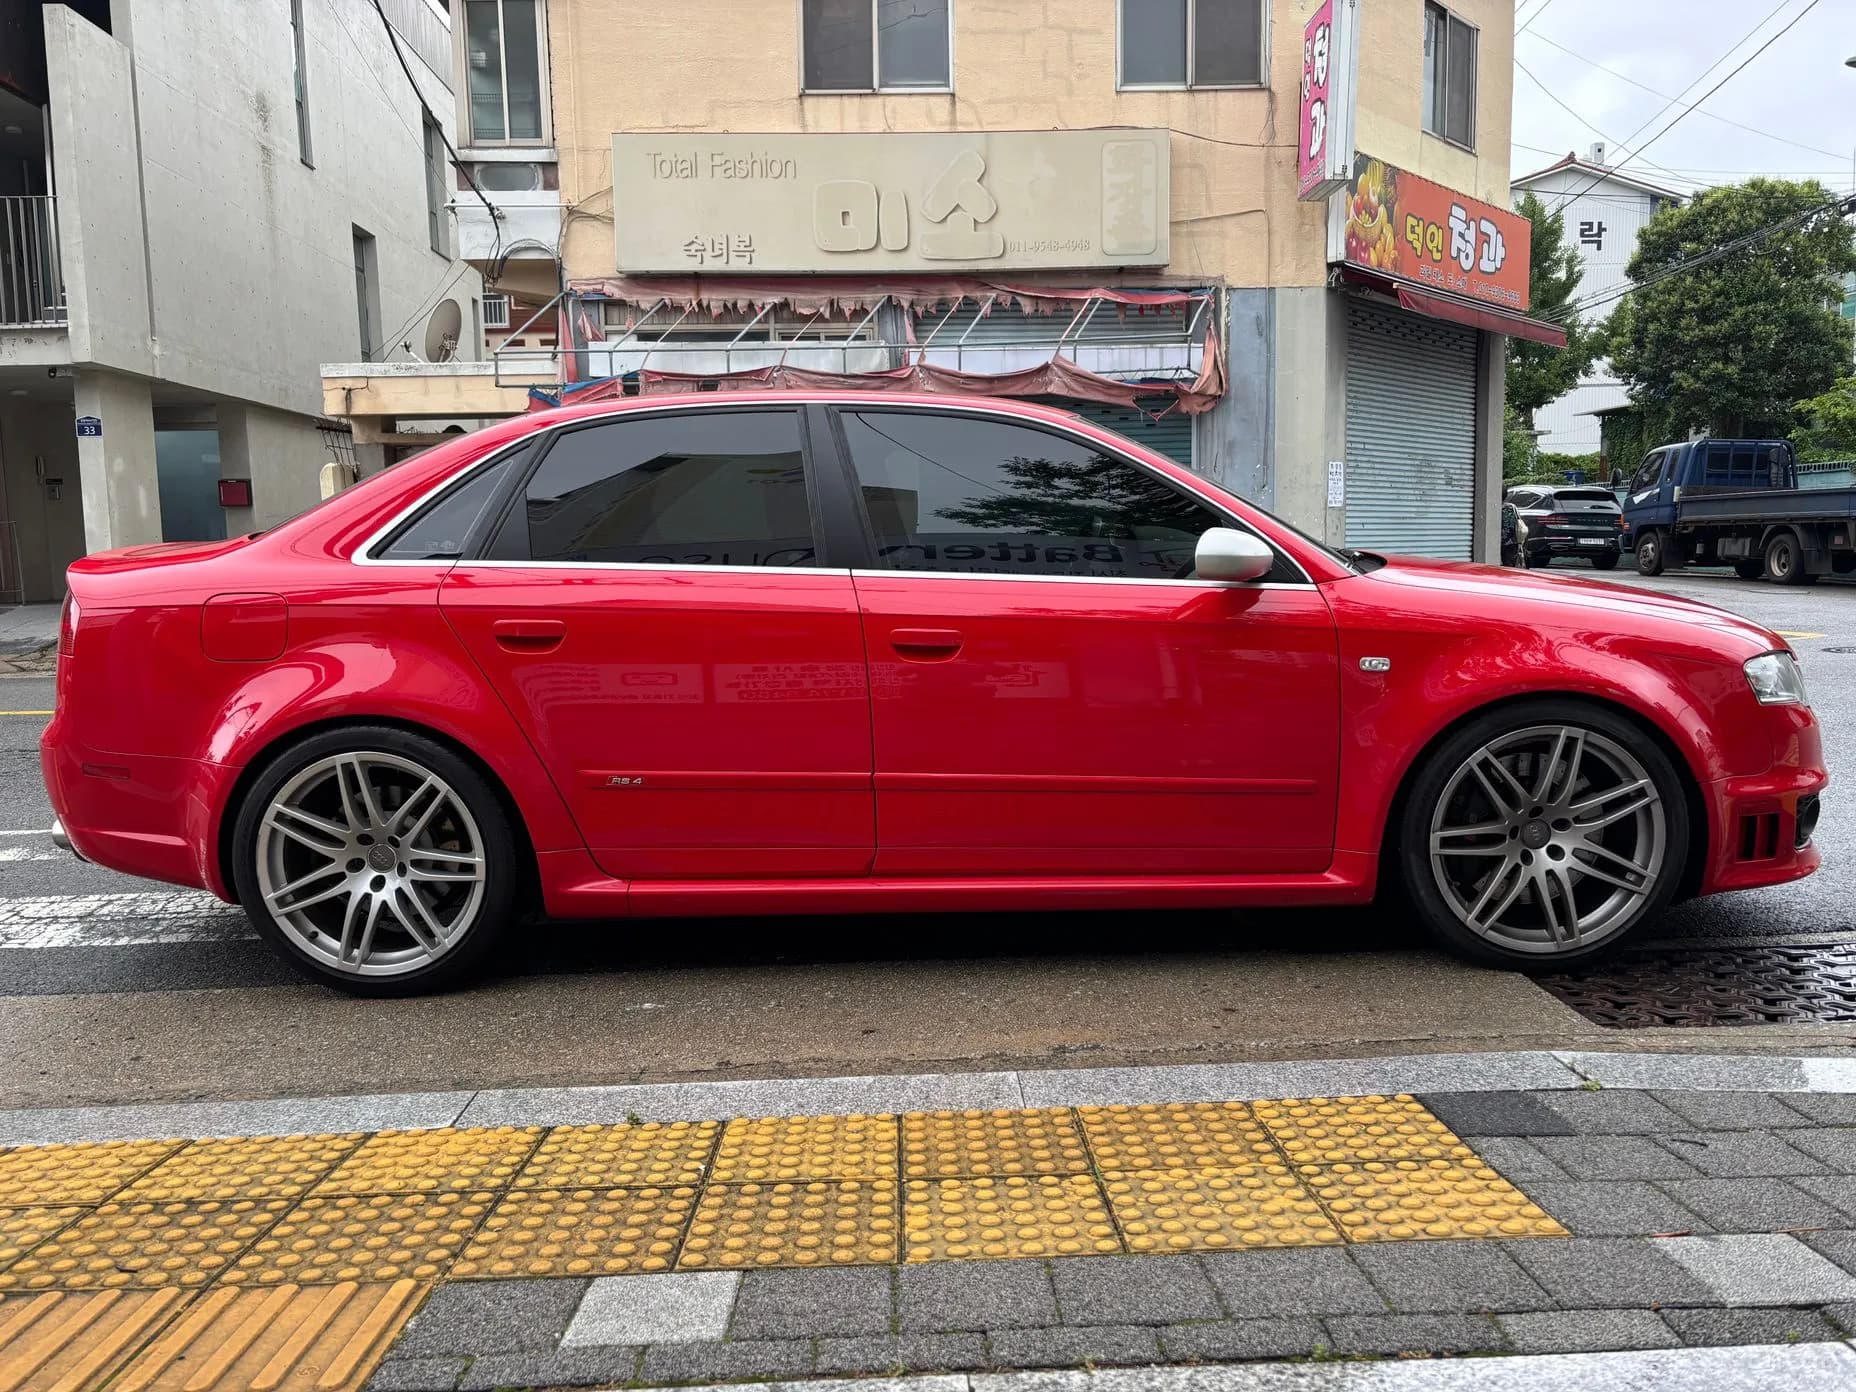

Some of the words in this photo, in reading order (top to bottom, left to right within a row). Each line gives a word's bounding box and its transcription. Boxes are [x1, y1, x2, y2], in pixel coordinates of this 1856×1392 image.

[1309, 22, 1330, 161] 청과
[647, 152, 699, 179] Total
[710, 150, 797, 179] Fashion
[813, 149, 1004, 260] 미소
[682, 233, 756, 265] 숙녀복
[1405, 213, 1443, 262] 덕인
[1448, 203, 1506, 274] 청과
[1579, 220, 1607, 251] 락
[83, 426, 96, 435] 33
